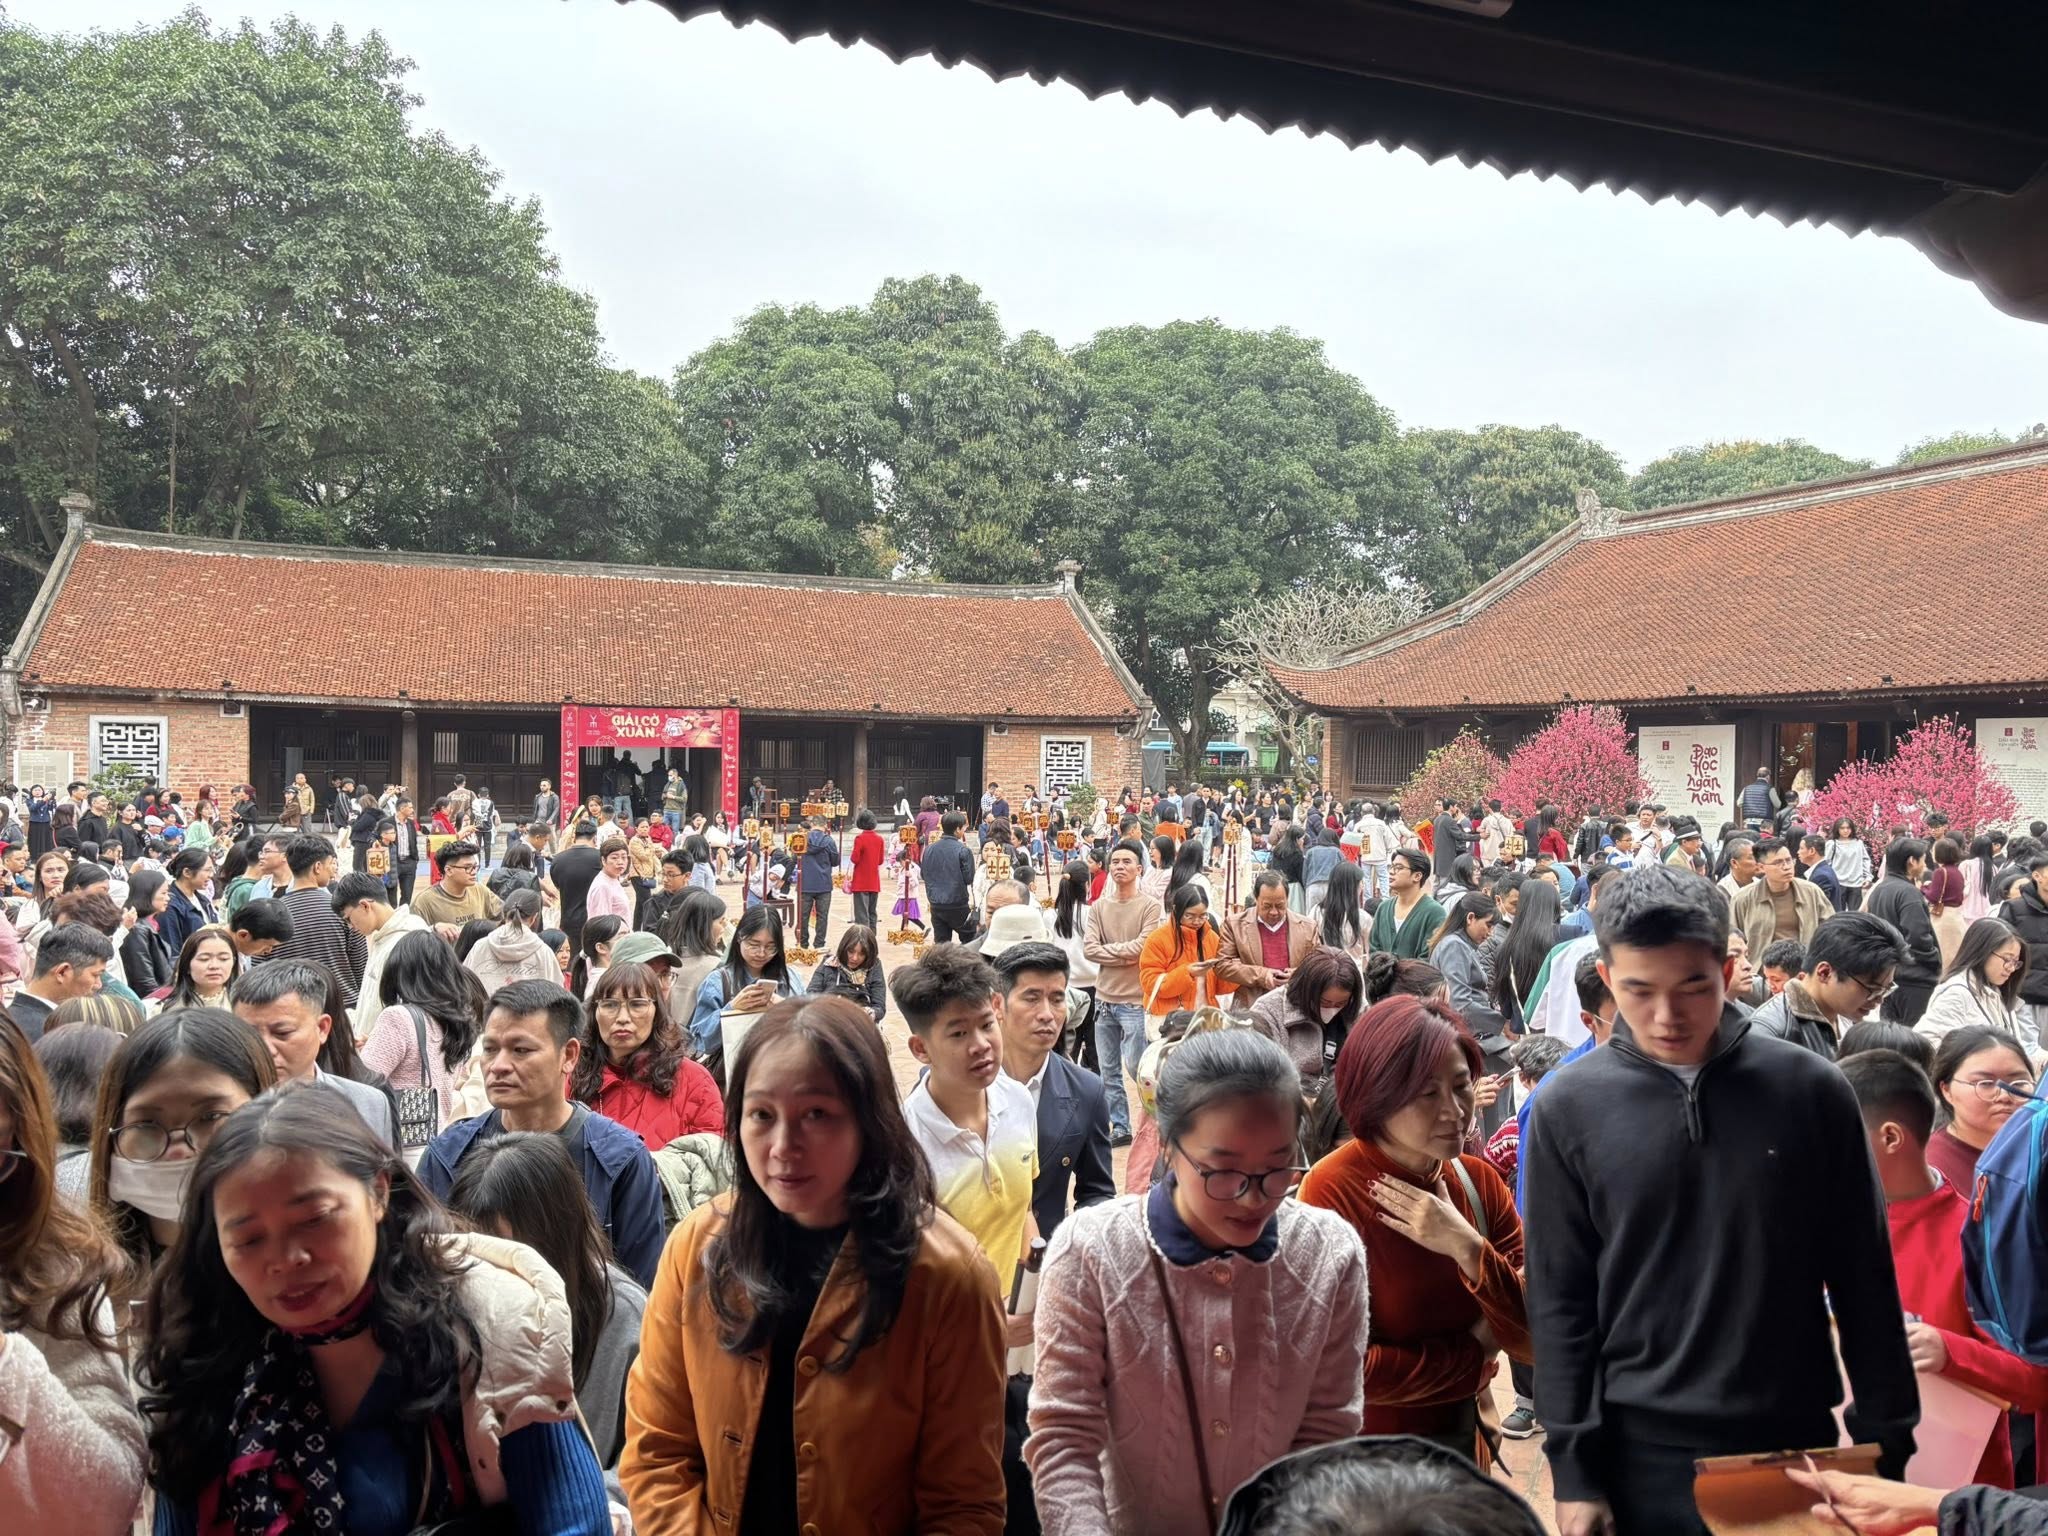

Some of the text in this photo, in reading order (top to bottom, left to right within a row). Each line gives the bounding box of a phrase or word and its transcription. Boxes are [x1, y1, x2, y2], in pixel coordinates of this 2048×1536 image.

[611, 712, 639, 726] GIẢI
[641, 712, 660, 727] CỜ
[616, 724, 656, 738] XUÂN
[1692, 744, 1718, 760] Đạo
[1690, 754, 1718, 778] Học
